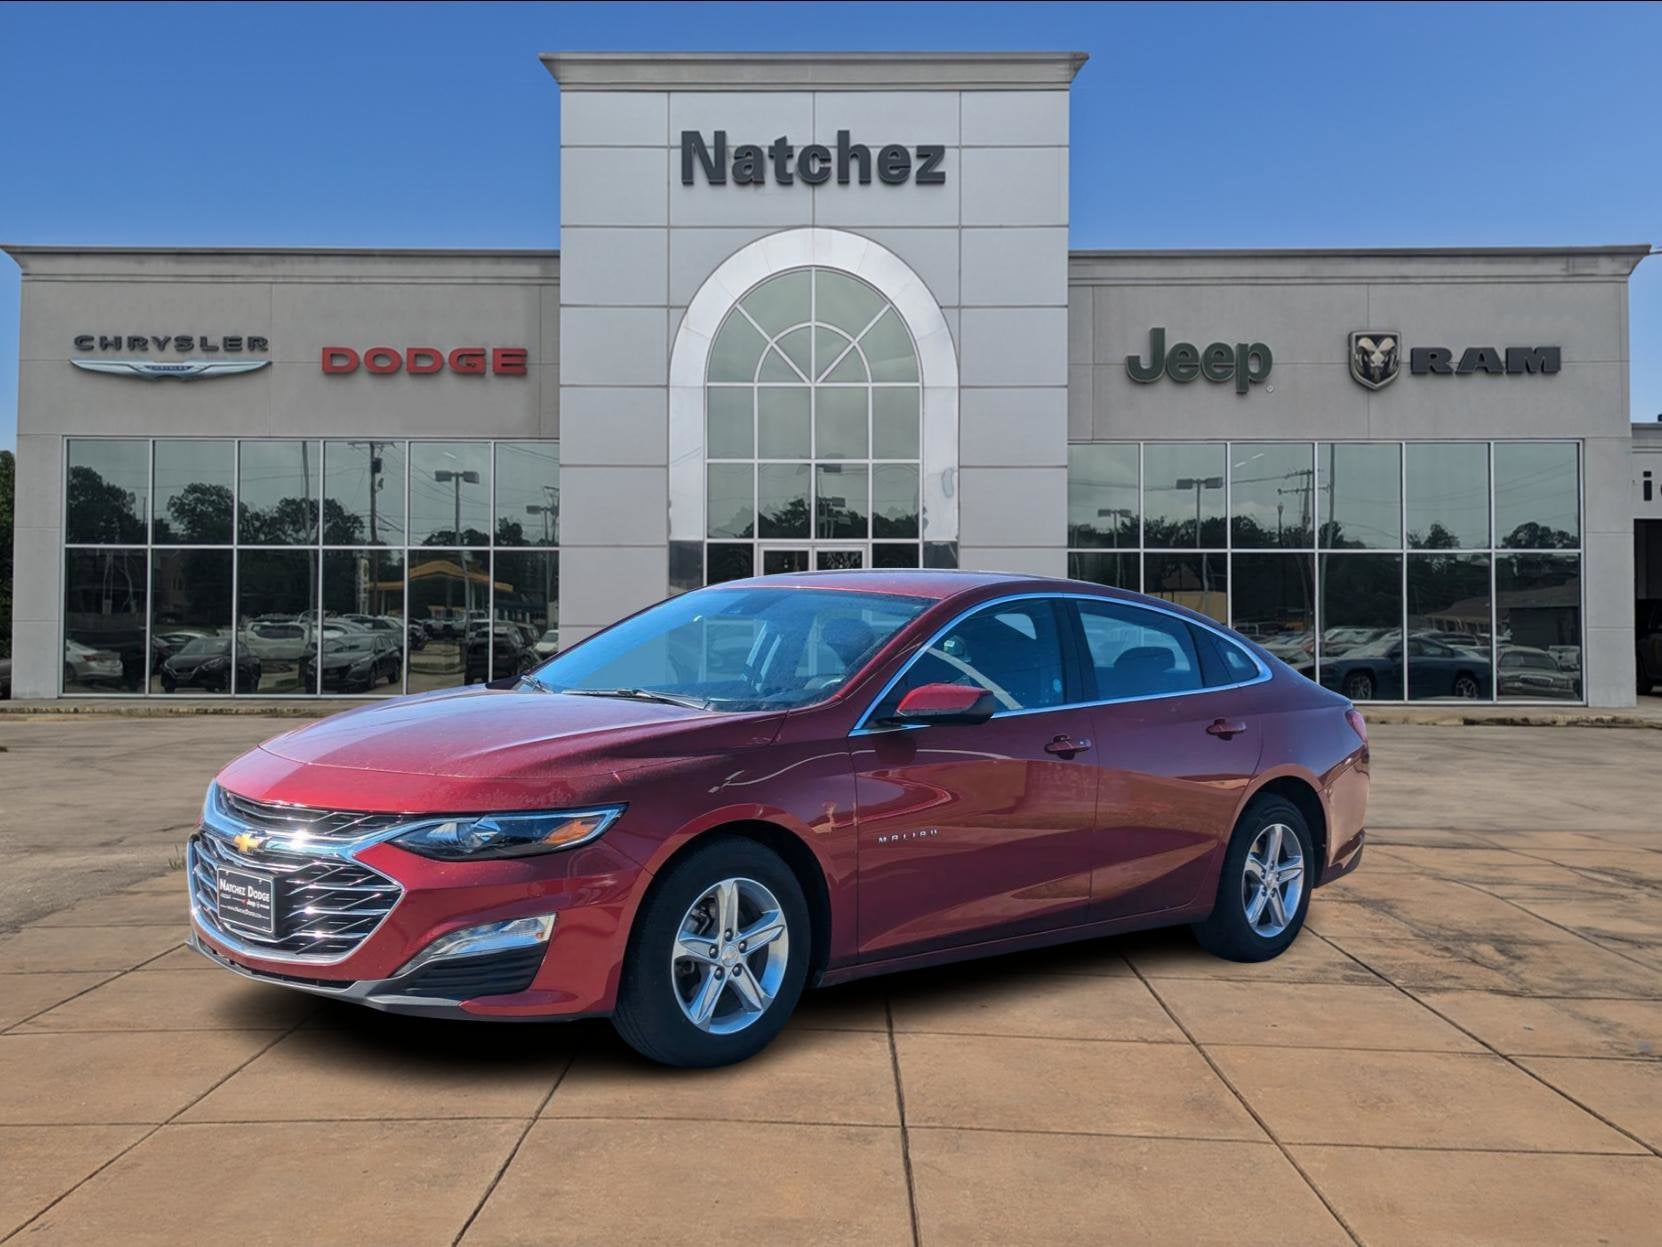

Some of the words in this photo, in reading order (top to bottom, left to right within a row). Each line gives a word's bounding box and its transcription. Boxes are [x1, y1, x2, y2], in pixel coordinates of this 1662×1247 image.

[681, 130, 946, 186] Natchez
[74, 335, 269, 352] CHRYSLER
[322, 347, 528, 375] DODGE
[1126, 327, 1273, 395] Jeep
[1410, 346, 1562, 375] RAM
